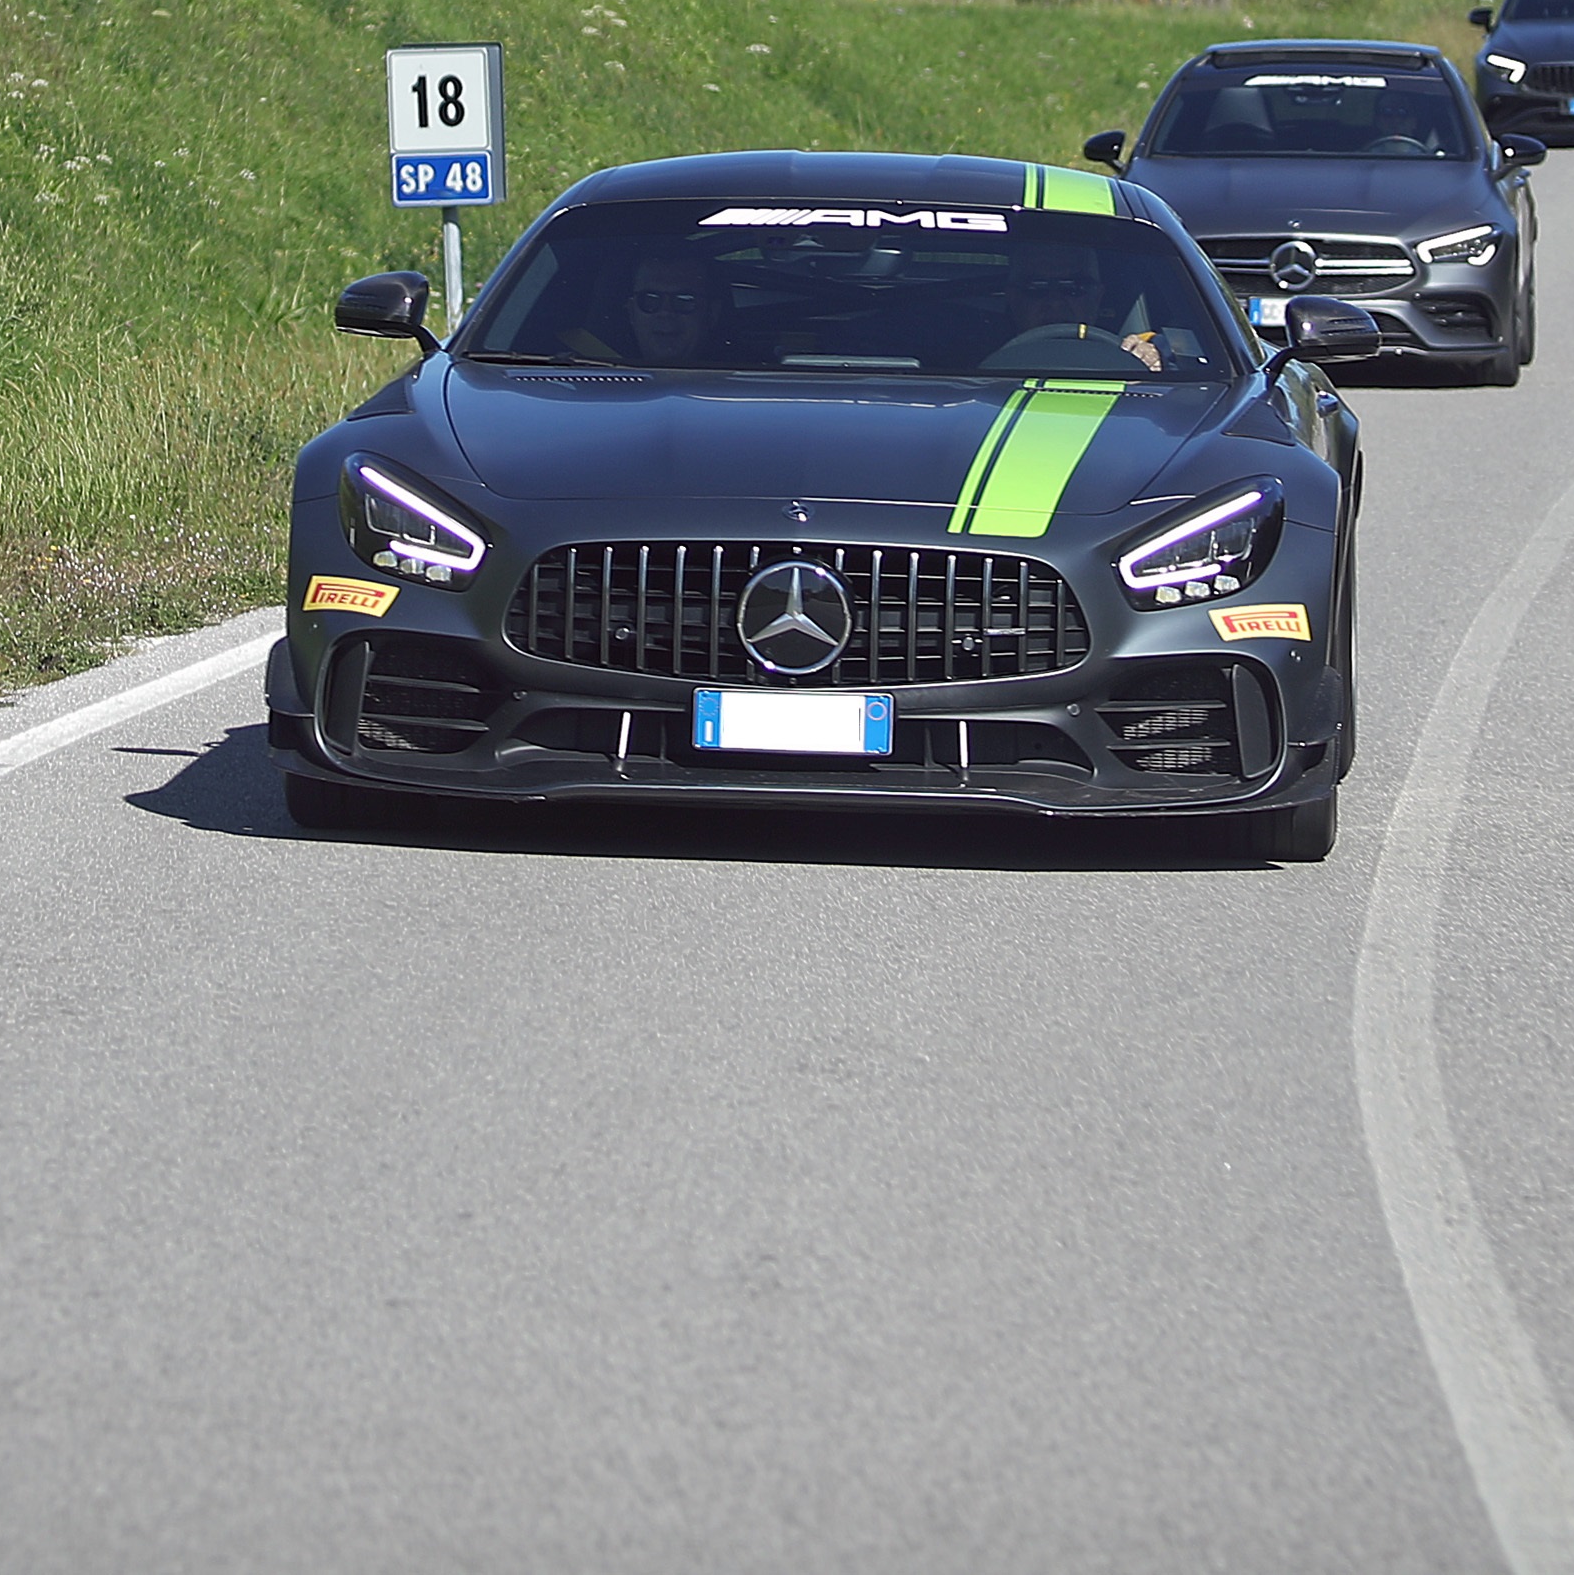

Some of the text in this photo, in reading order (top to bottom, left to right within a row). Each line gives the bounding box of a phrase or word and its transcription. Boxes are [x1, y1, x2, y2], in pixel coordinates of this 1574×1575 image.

[411, 74, 465, 128] 18
[400, 161, 483, 195] SP 48
[792, 208, 1008, 232] AMG
[311, 582, 386, 609] PIRELLI
[1221, 610, 1302, 633] PIRELLI
